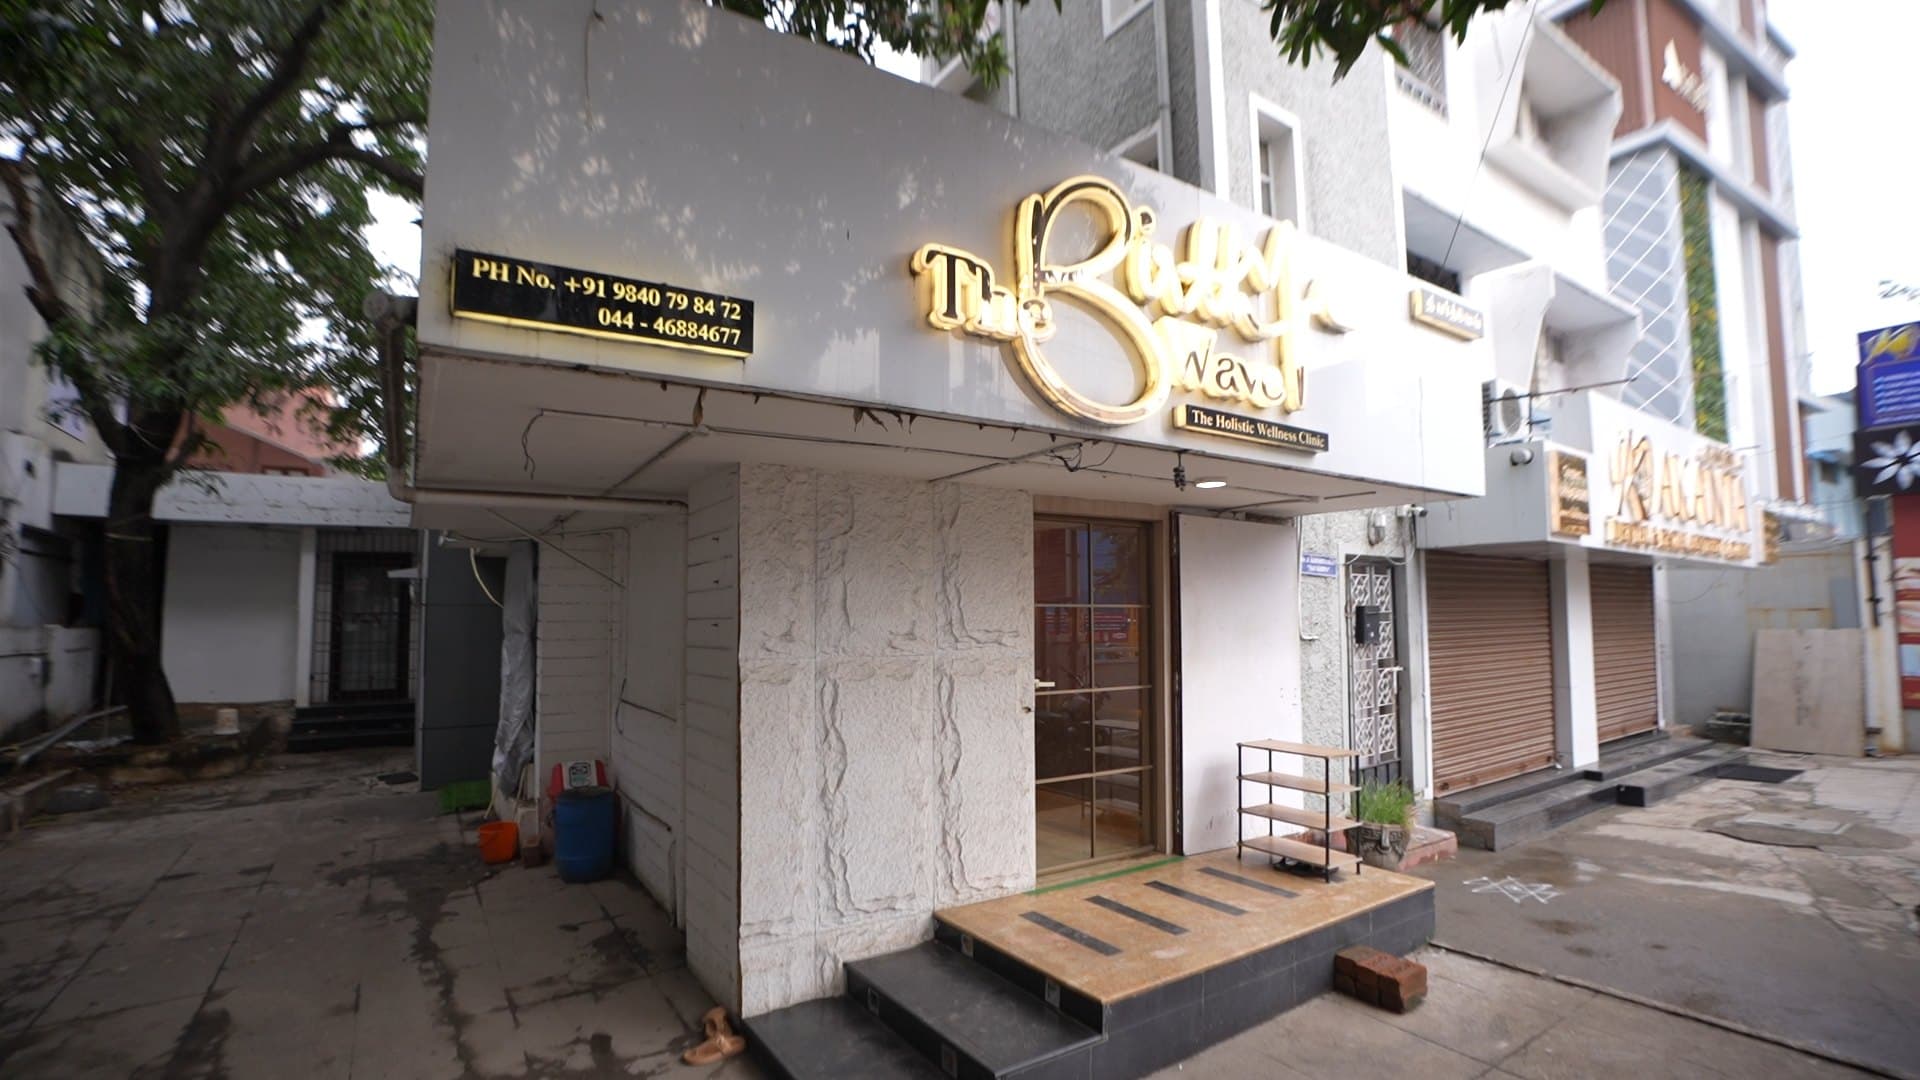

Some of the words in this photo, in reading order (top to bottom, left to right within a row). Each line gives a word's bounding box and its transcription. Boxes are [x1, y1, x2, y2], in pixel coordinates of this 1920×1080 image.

[472, 257, 510, 283] PH
[516, 264, 556, 290] No.
[563, 276, 607, 299] +91
[612, 281, 661, 307] 9840
[666, 292, 689, 311] 79
[693, 296, 716, 317] 84
[720, 301, 742, 321] 72
[598, 307, 635, 330] 044
[653, 316, 742, 346] 46884677
[1191, 409, 1214, 427] The
[1215, 413, 1256, 435] Holistic
[1256, 422, 1298, 443] Wellness
[1298, 430, 1326, 448] Clinic
